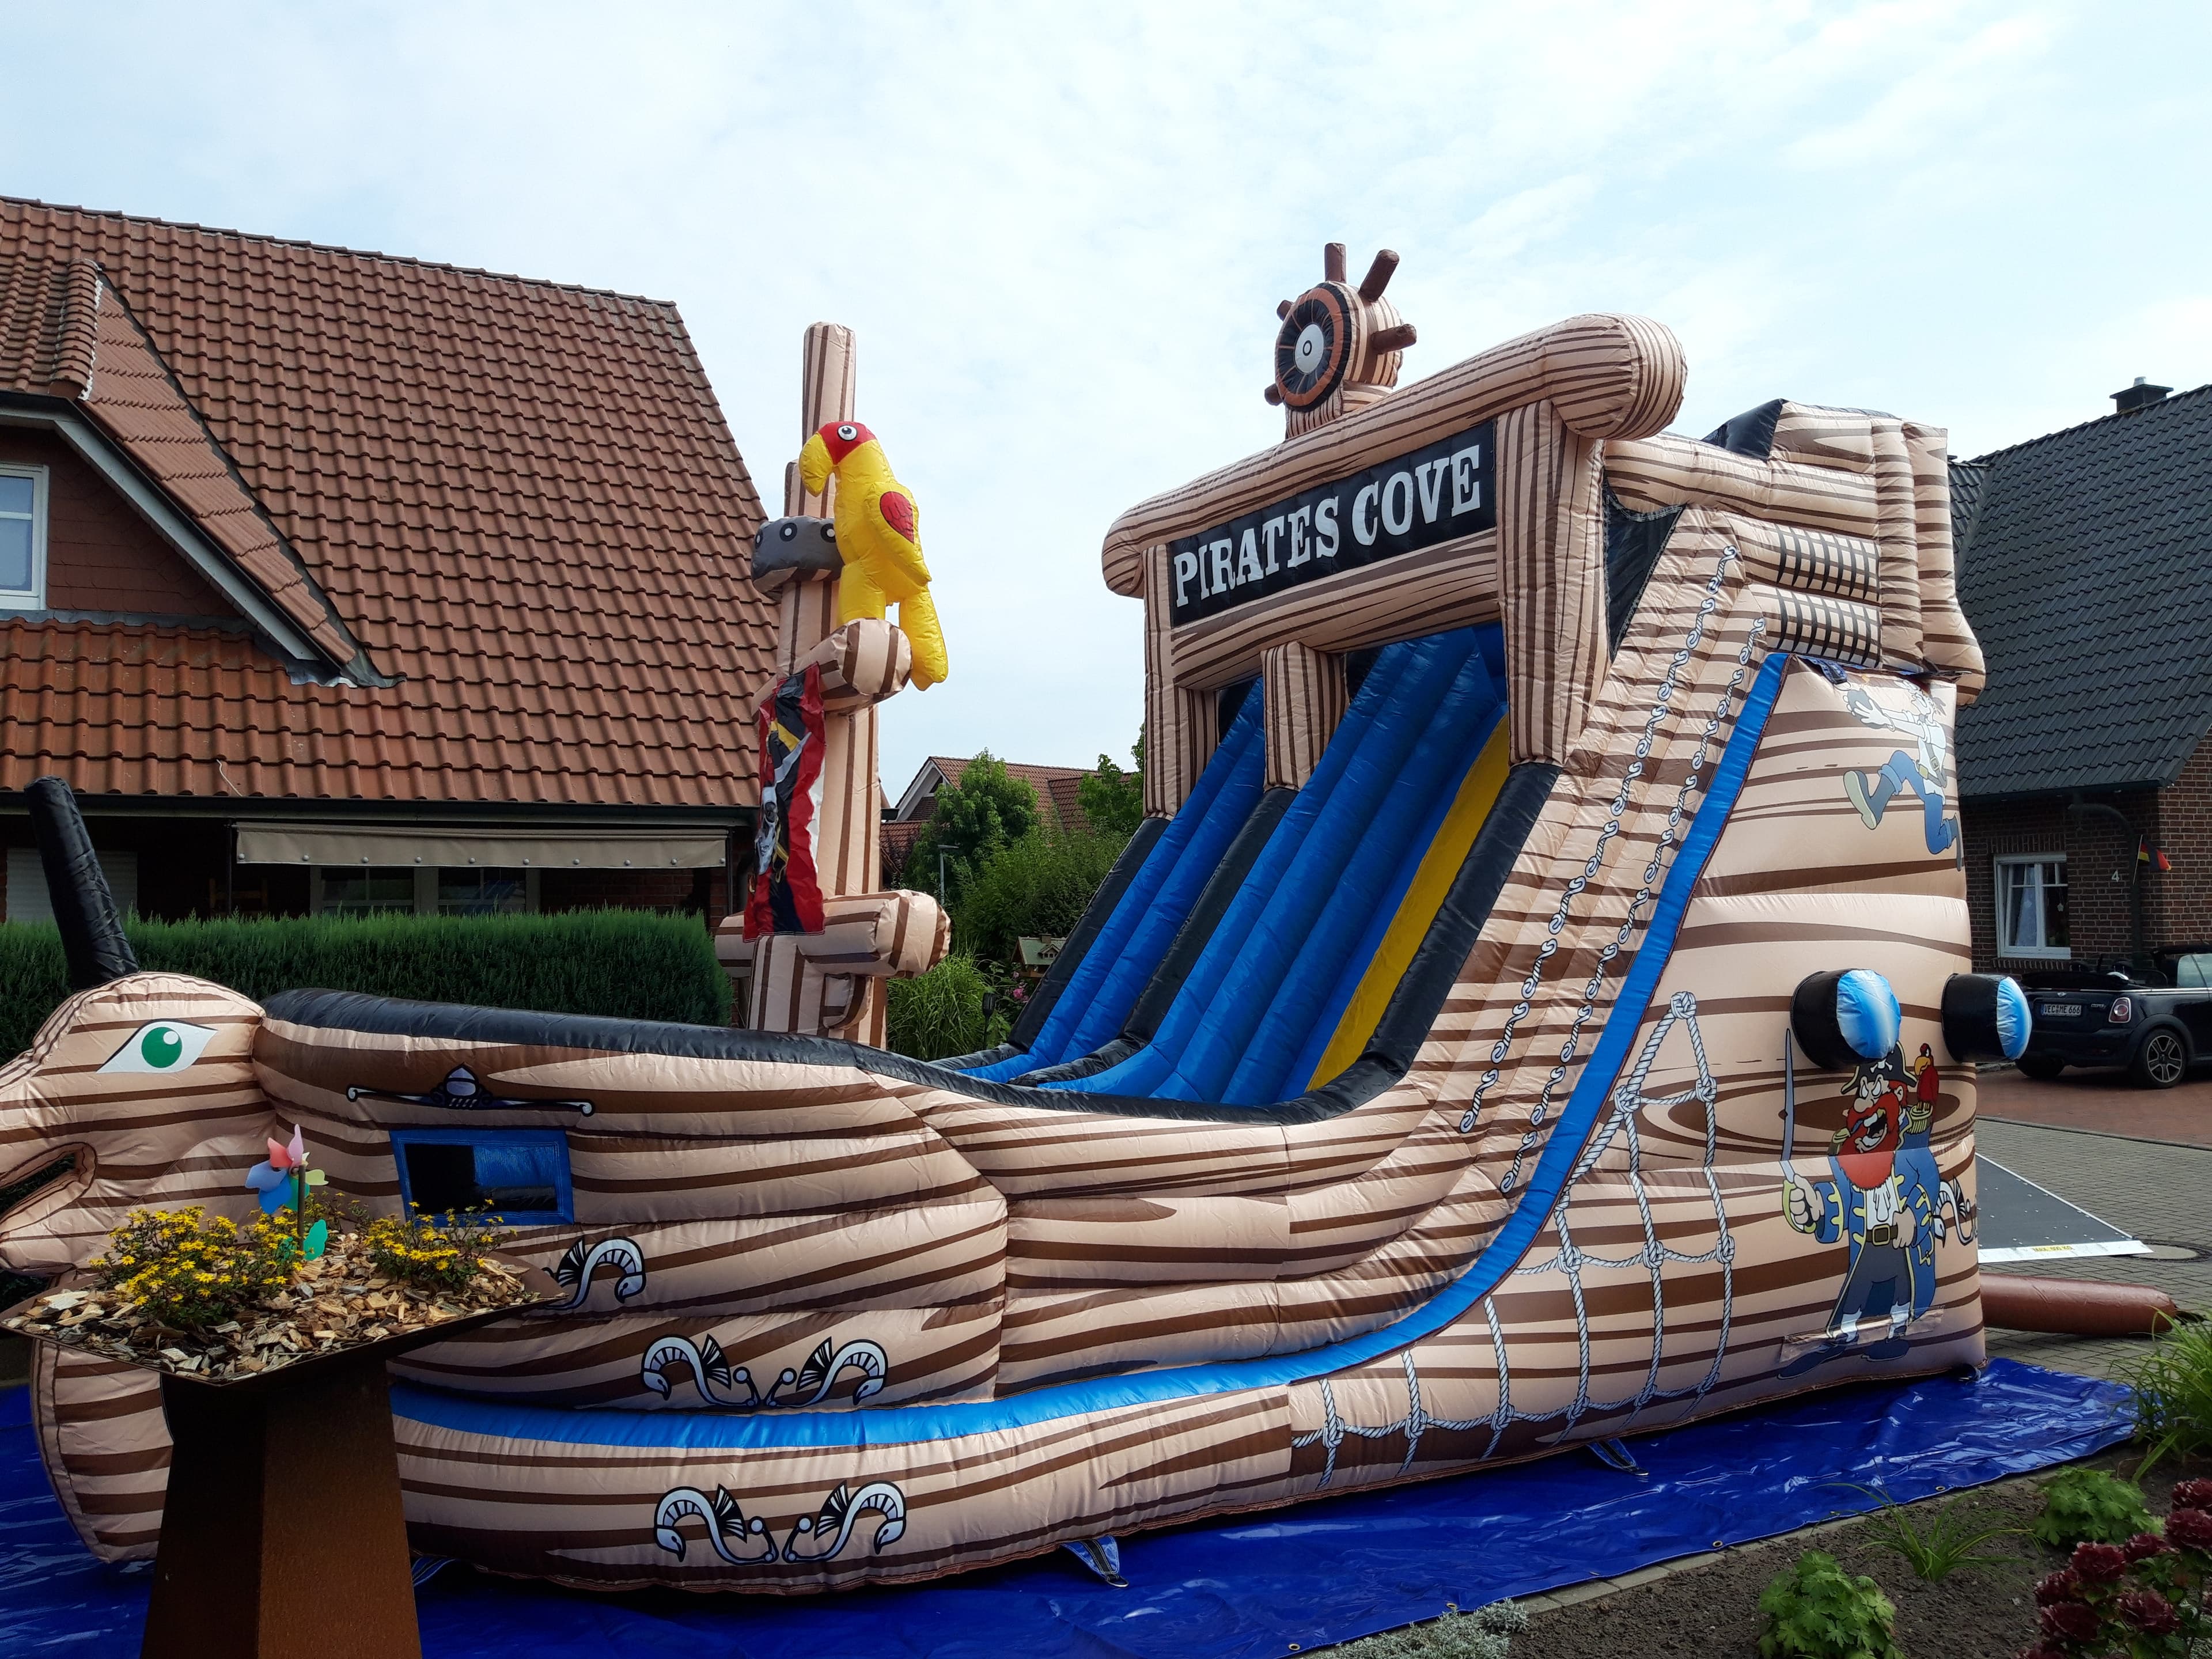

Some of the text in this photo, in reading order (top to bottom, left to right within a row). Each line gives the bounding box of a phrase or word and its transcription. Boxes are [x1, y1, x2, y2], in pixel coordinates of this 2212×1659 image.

[1173, 444, 1481, 608] PIRATES COVE
[2111, 870, 2120, 882] 4
[2069, 1006, 2080, 1014] 666
